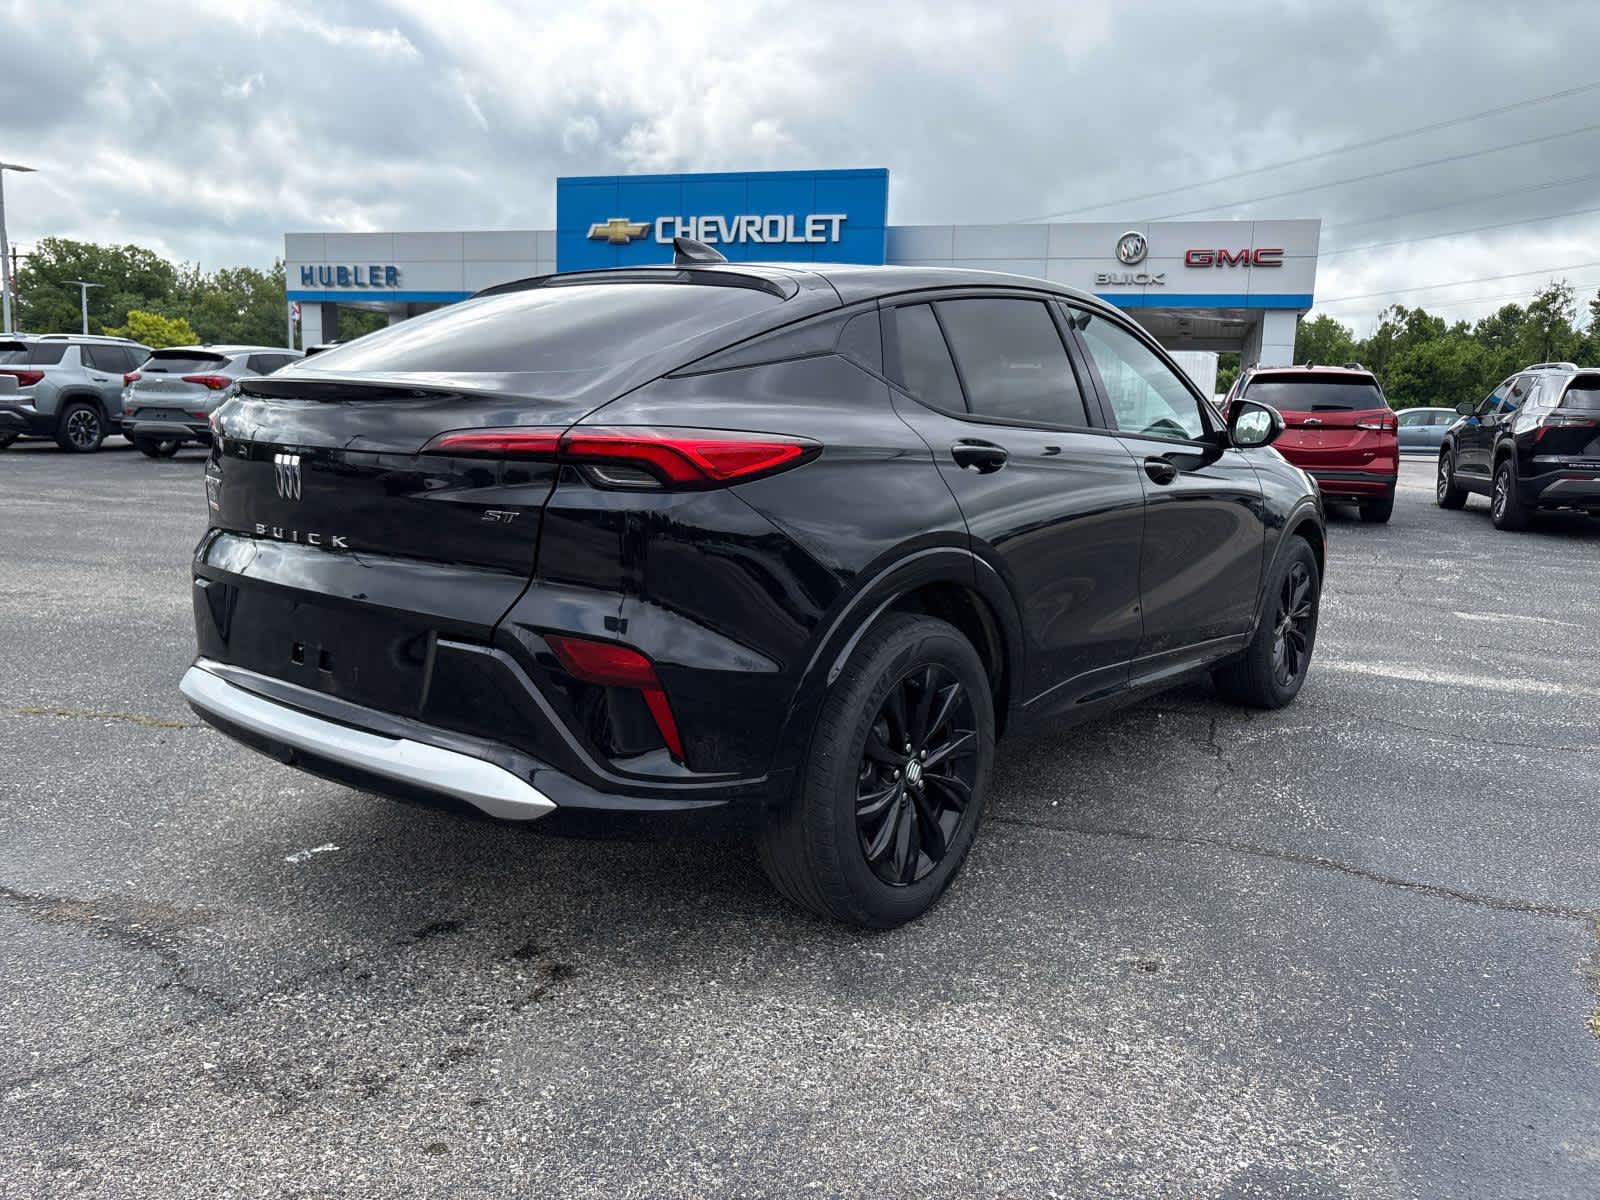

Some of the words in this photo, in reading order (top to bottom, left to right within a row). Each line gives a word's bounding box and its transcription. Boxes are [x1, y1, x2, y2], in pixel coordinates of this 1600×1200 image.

[655, 213, 848, 244] CHEVROLET
[1184, 248, 1284, 267] GMC
[300, 265, 401, 287] HUBLER
[1095, 272, 1166, 285] BUICK
[481, 510, 520, 523] ST
[255, 523, 349, 549] BUICK
